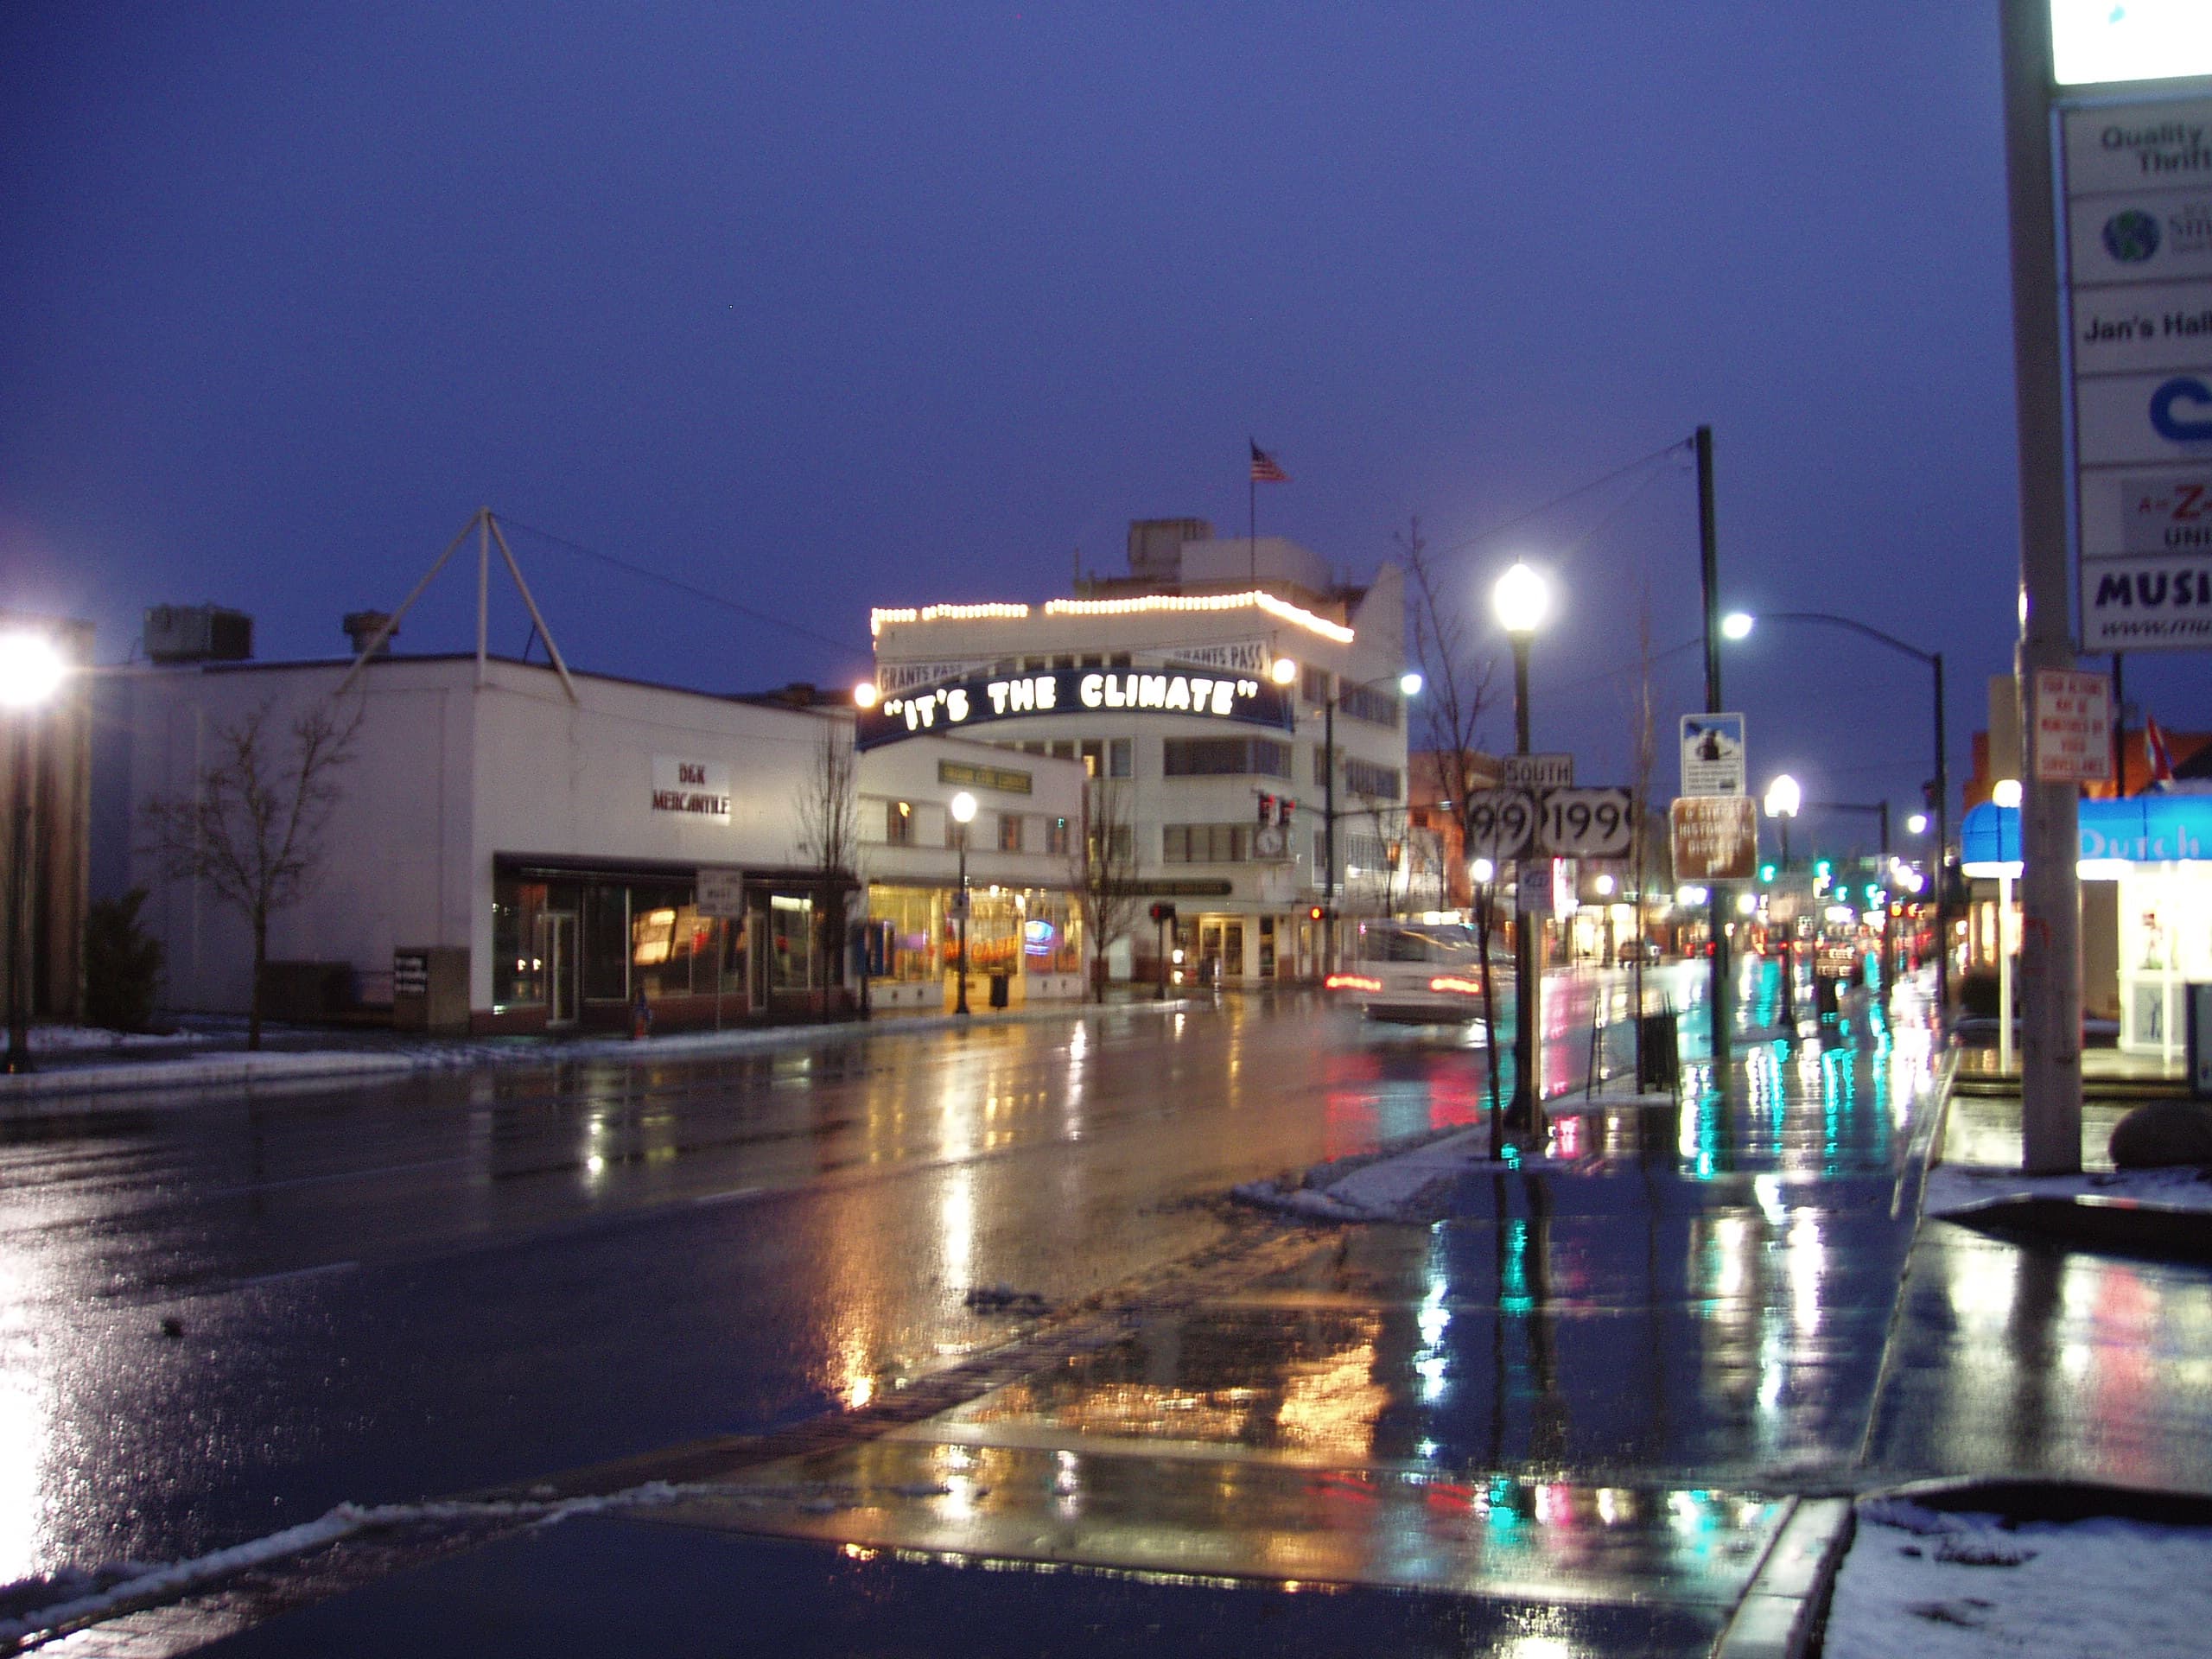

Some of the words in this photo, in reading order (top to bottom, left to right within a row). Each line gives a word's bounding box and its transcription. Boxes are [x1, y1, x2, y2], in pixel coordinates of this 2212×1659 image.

[2101, 124, 2202, 152] Quality
[2084, 315, 2155, 343] Jan's
[2095, 569, 2212, 607] MUSI
[988, 676, 1056, 715] THE
[679, 763, 706, 785] D&K
[1506, 759, 1569, 781] SOUTH
[652, 790, 731, 815] MERCANTILE
[1471, 802, 1527, 840] 99
[1554, 802, 1619, 841] 199
[2078, 823, 2200, 857] Dutch
